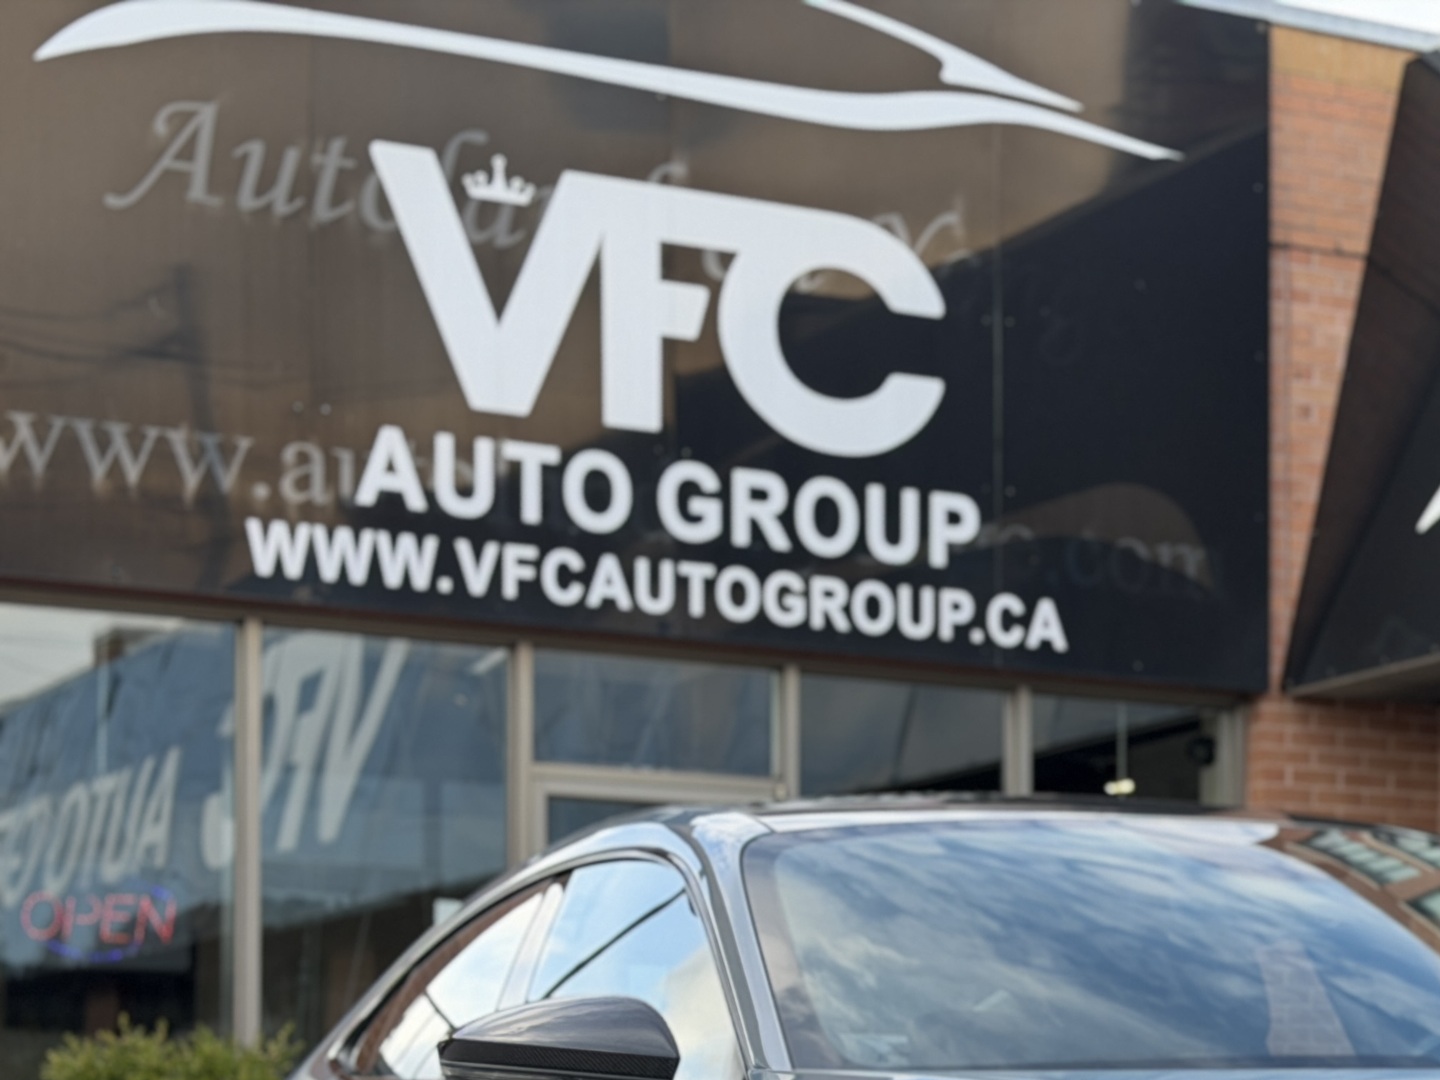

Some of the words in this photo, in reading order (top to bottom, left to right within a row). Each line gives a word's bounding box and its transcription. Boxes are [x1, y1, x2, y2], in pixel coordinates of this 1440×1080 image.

[368, 138, 946, 457] VFC
[354, 424, 633, 534] AUTO
[656, 459, 981, 569] GROUP
[244, 515, 1068, 653] WWW.VFCAUTOGROUP.CA
[21, 889, 177, 943] OPEN
